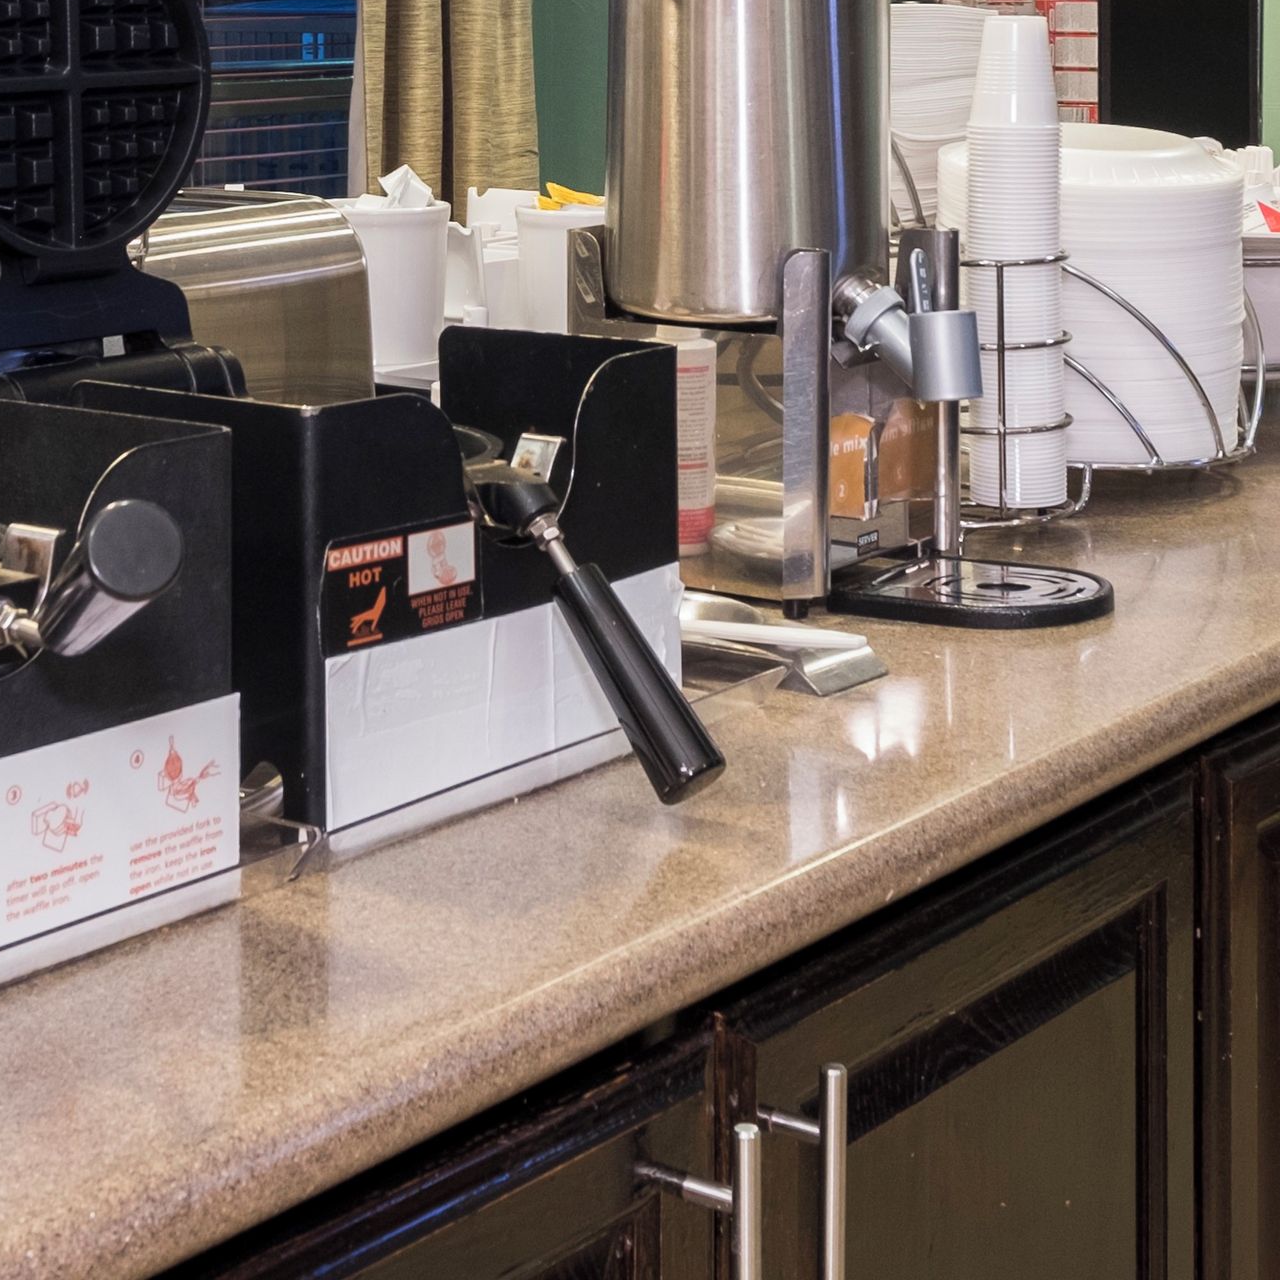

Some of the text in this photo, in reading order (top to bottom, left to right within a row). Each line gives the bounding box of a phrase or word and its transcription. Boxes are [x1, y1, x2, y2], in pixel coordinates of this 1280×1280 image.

[843, 434, 868, 454] mix
[858, 533, 878, 545] SERVER
[329, 539, 402, 567] CAUTION
[348, 567, 382, 589] HOT
[411, 594, 432, 608] WHEN
[433, 590, 447, 602] NOT
[448, 589, 456, 598] IN
[418, 596, 466, 618] PLEASE LEAVE
[422, 609, 464, 628] GRIDS OPEN
[129, 816, 222, 852] use the provided fork to
[129, 829, 224, 867] remove the waffle from
[6, 854, 104, 893] after two minutes the
[129, 870, 143, 880] the
[165, 857, 184, 869] keep
[185, 851, 198, 861] the
[200, 846, 217, 857] iron
[6, 893, 29, 907] timer
[31, 884, 47, 898] will
[49, 882, 60, 895] go
[78, 869, 100, 884] open
[129, 882, 152, 895] open
[154, 873, 174, 887] while
[176, 867, 189, 877] not
[191, 865, 199, 873] in
[6, 911, 21, 922] the
[23, 900, 50, 916] waffle
